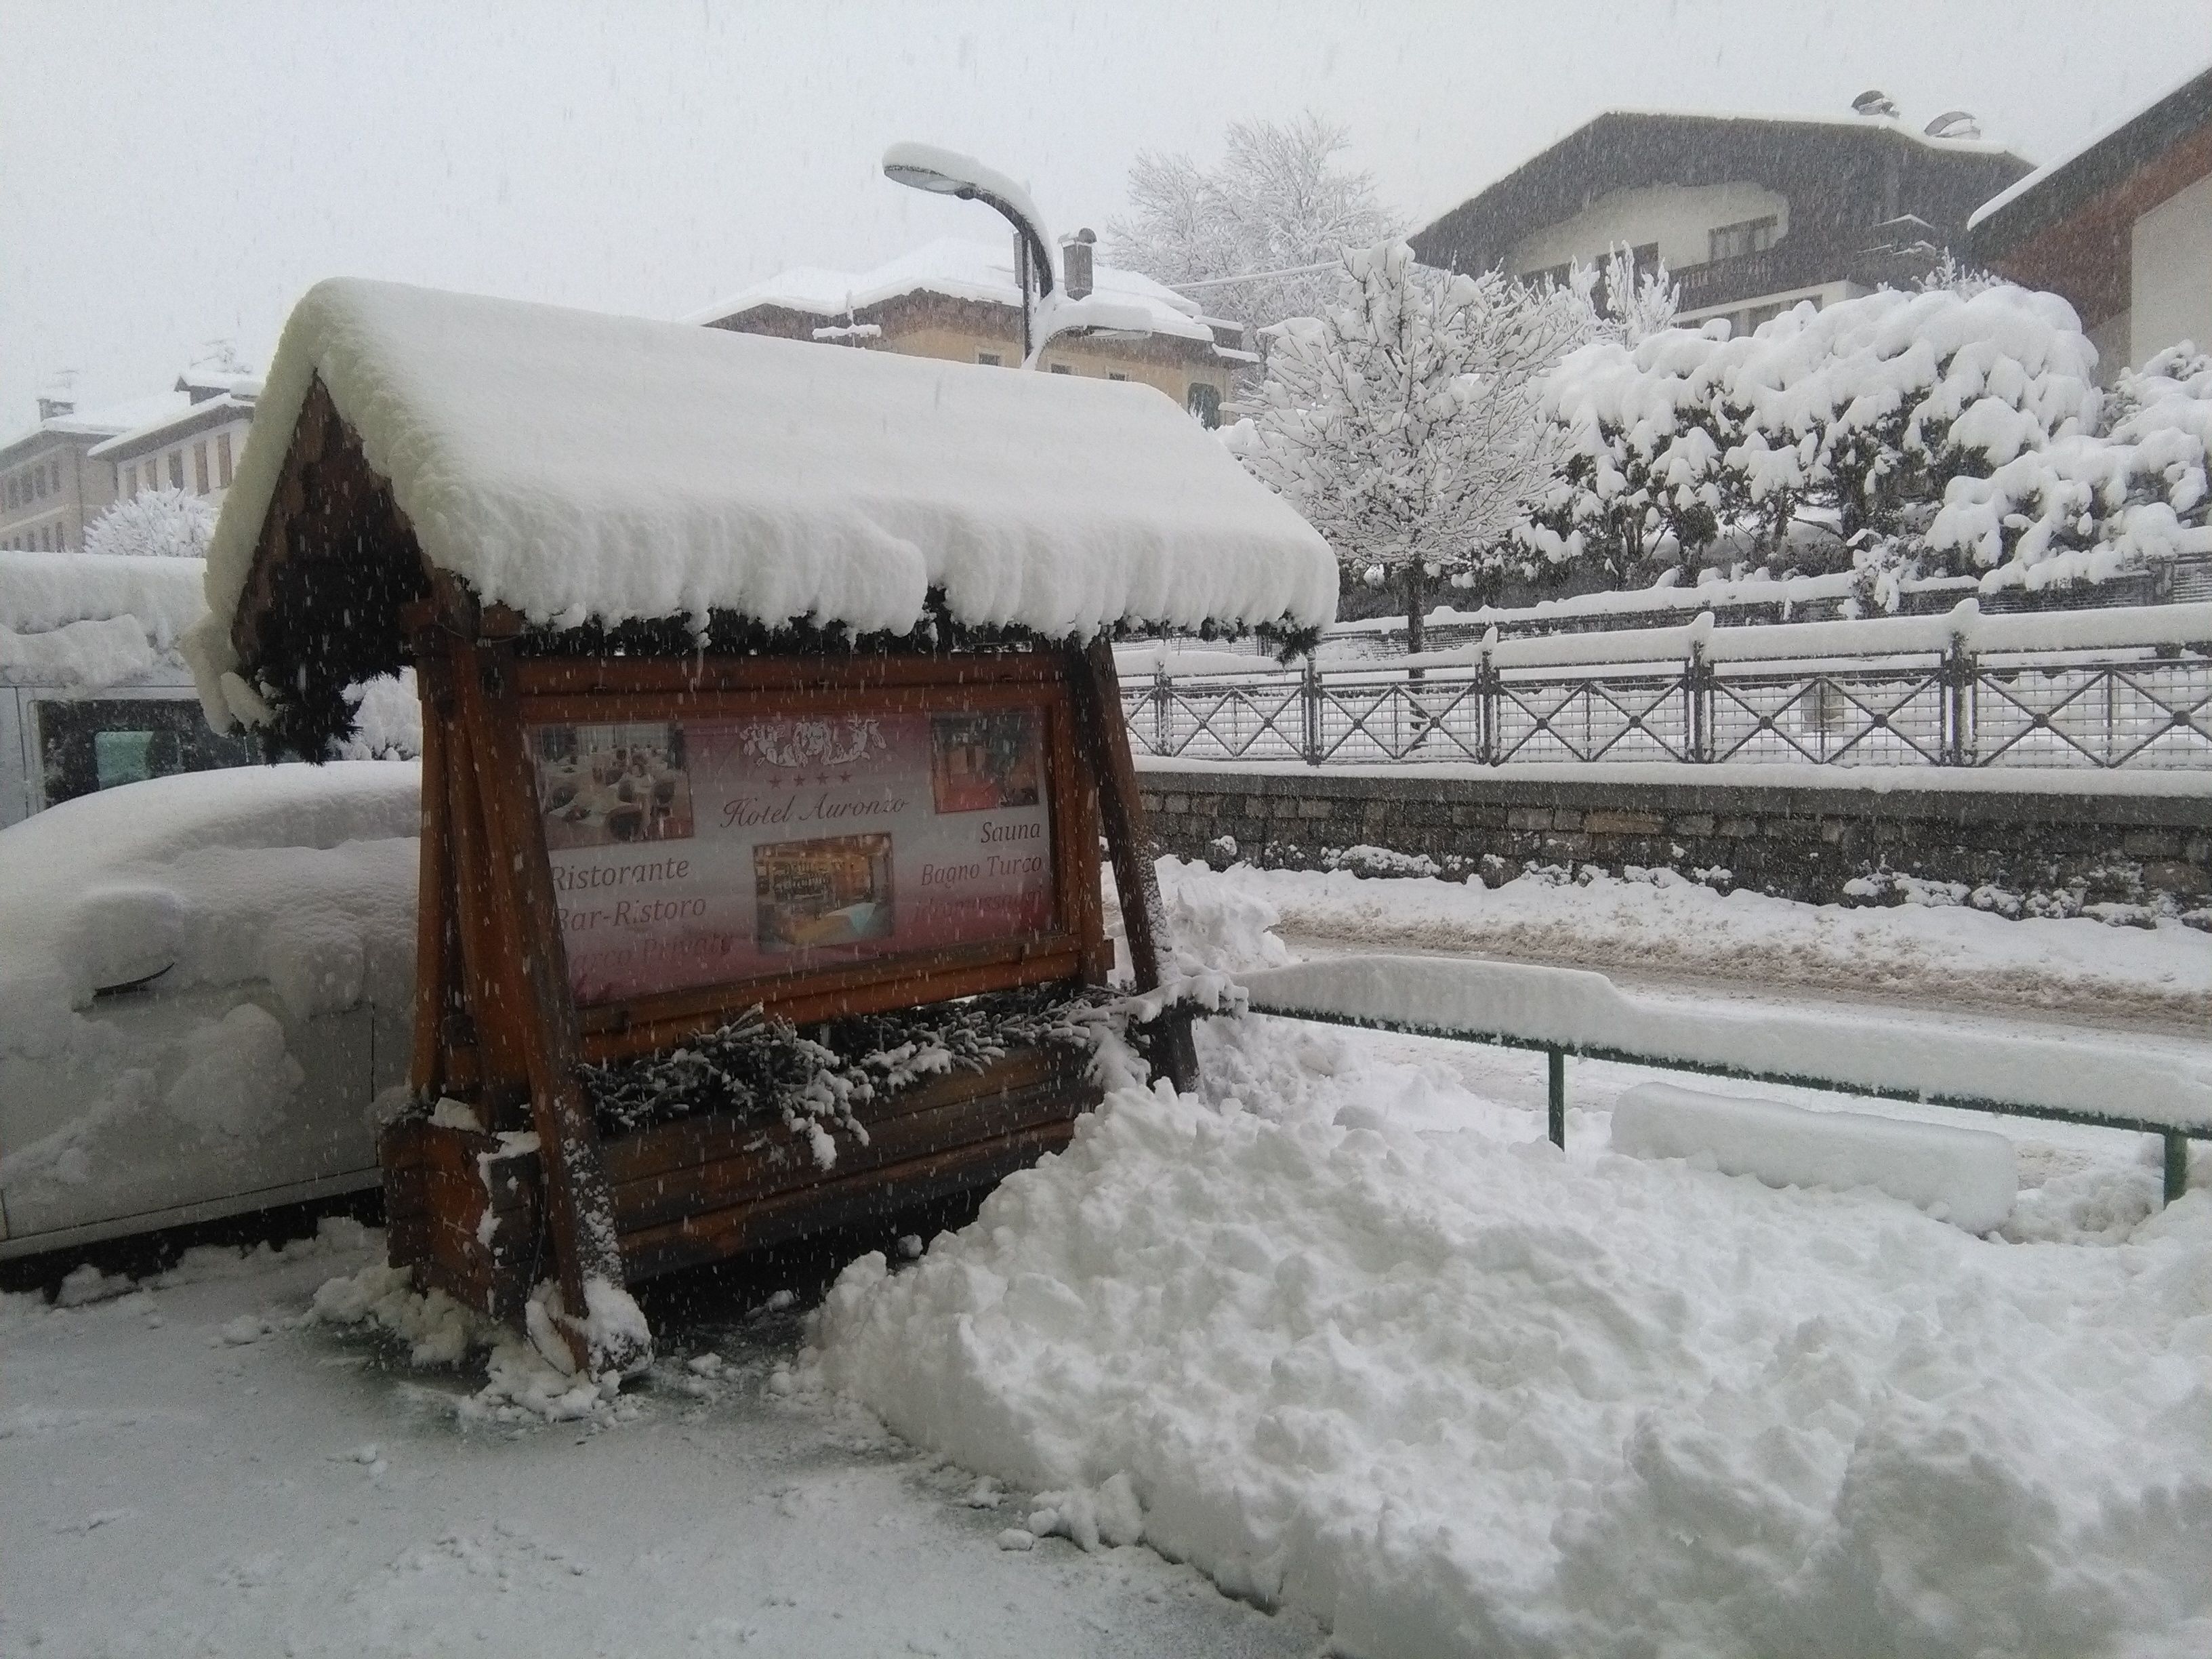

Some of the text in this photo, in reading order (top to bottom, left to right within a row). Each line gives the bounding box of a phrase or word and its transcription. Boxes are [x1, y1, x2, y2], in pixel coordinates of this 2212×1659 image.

[720, 792, 909, 829] Hotel Auronzo
[980, 821, 1041, 844] Sauna
[551, 857, 690, 890] Ristorante
[922, 855, 1042, 889] Bagno Turco
[557, 898, 707, 931] Bar-Ristoro
